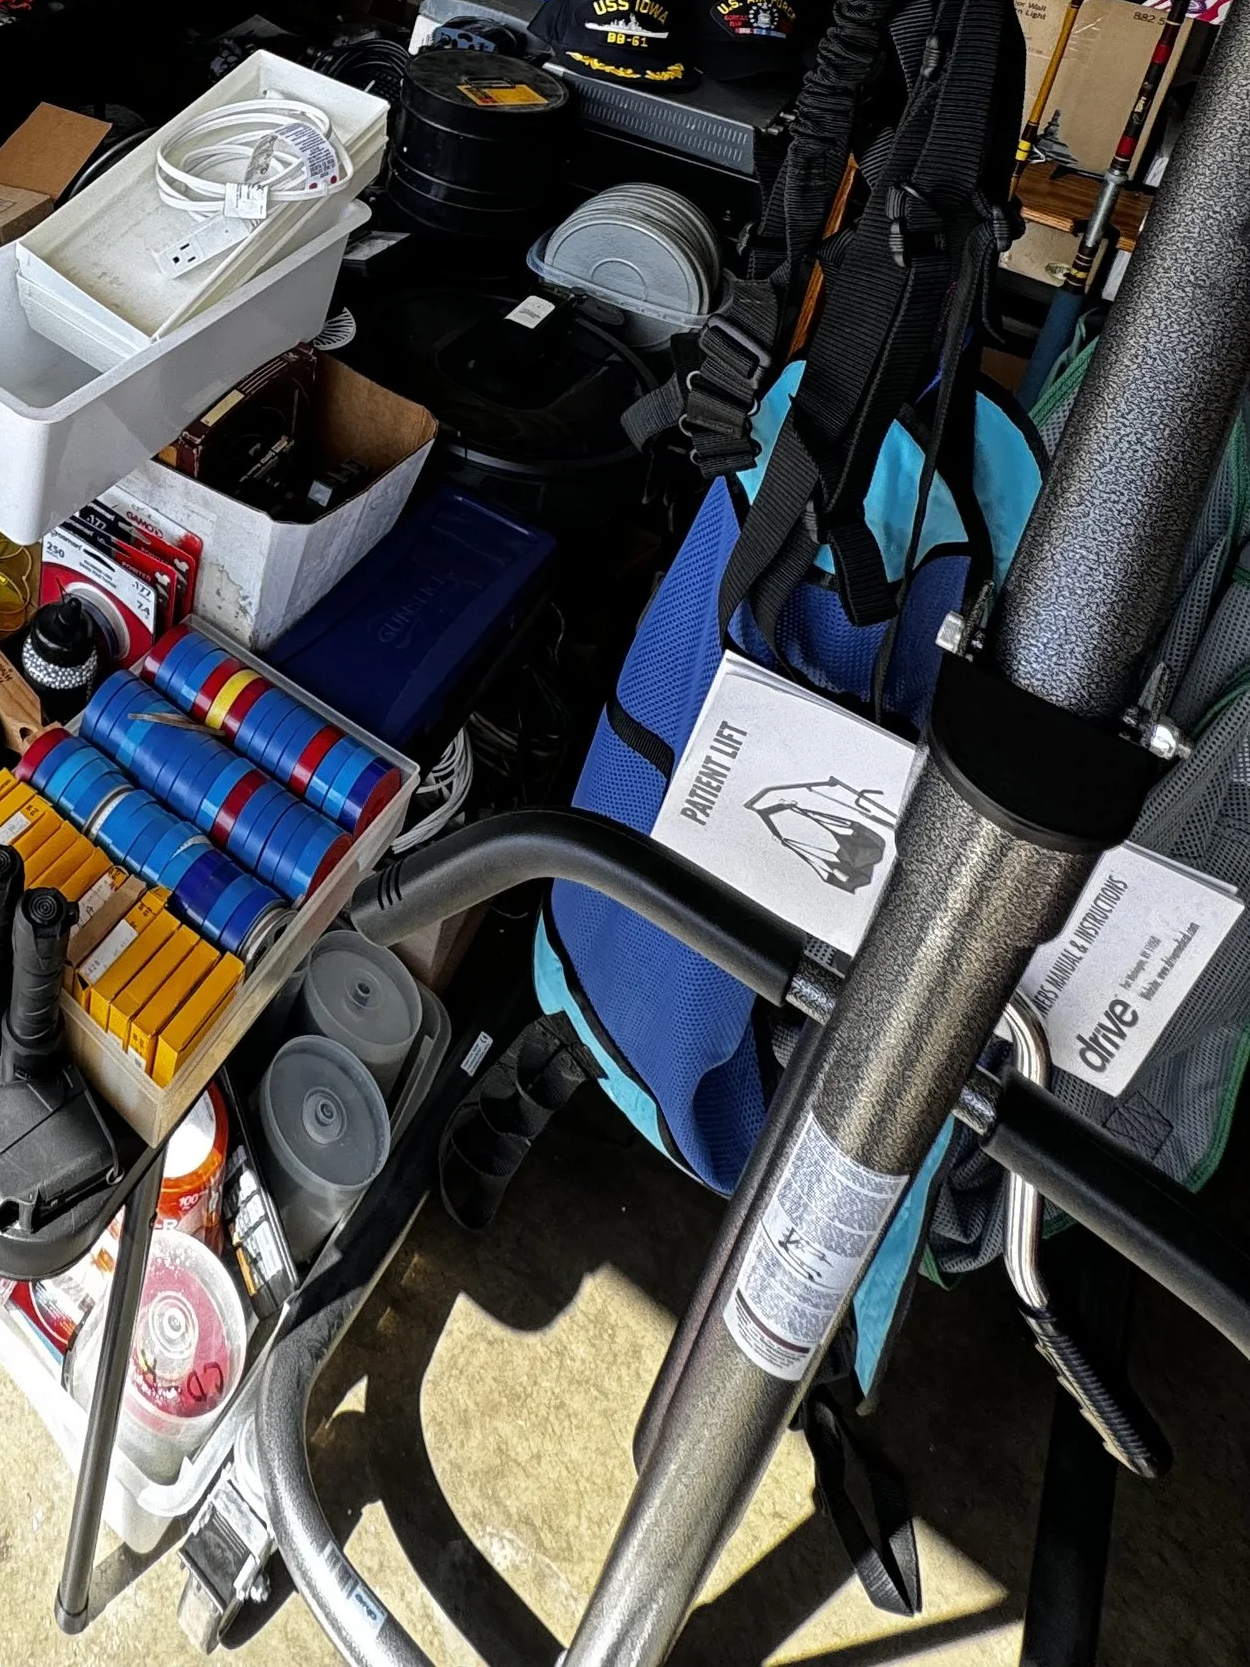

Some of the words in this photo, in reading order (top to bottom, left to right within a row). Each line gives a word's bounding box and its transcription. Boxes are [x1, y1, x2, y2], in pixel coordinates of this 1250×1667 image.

[1025, 9, 1047, 21] Light
[1028, 2, 1047, 12] Wall
[606, 32, 649, 48] BB-61
[46, 541, 65, 559] 250
[679, 754, 732, 826] PATIENT
[709, 719, 748, 760] LIFT
[1073, 874, 1129, 946] INSTRUCTIONS
[1068, 939, 1089, 956] &
[1048, 947, 1084, 993] MANUAL
[1033, 983, 1059, 1018] NERS
[1075, 998, 1140, 1074] drive
[178, 1193, 200, 1207] 100
